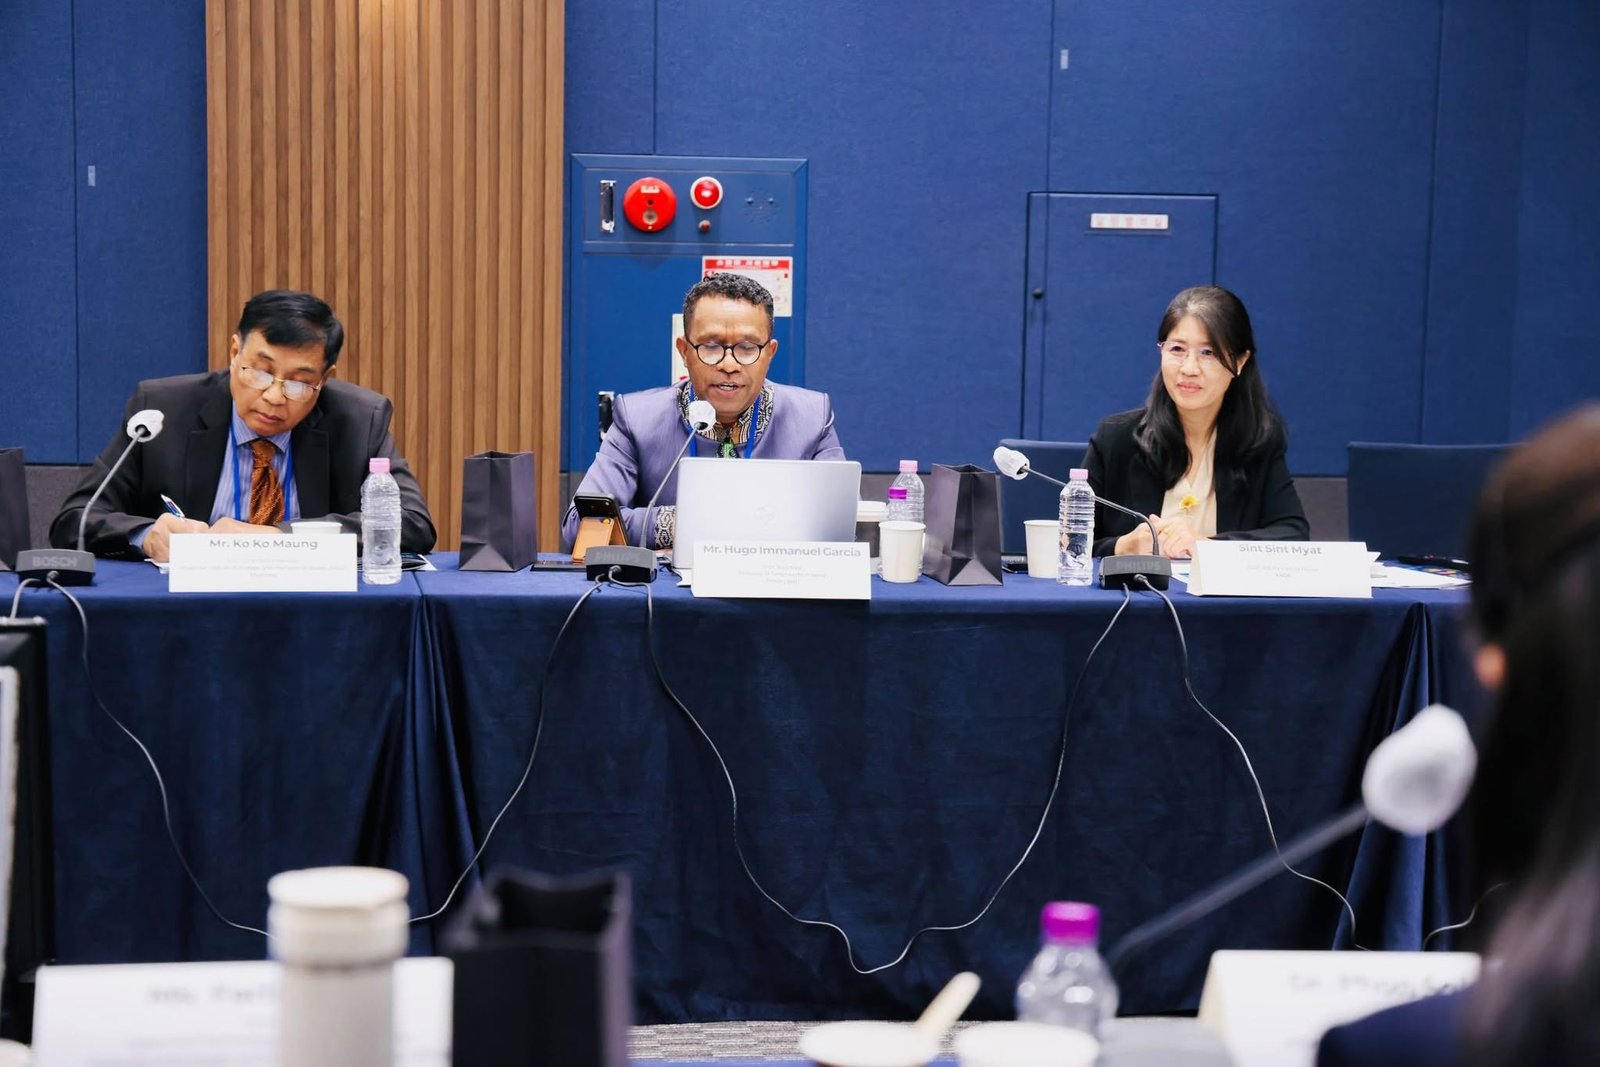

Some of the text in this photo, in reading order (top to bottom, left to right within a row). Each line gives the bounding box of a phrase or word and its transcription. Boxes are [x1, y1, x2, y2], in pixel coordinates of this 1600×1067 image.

[209, 539, 318, 551] Mr. Ko Ko Maung
[703, 545, 722, 554] Mr.
[724, 545, 757, 556] Hugo
[759, 546, 820, 557] Immanuel
[1239, 544, 1322, 557] Sint Sint Myat
[31, 556, 77, 567] BOSCH
[1117, 560, 1161, 571] PHILIPS
